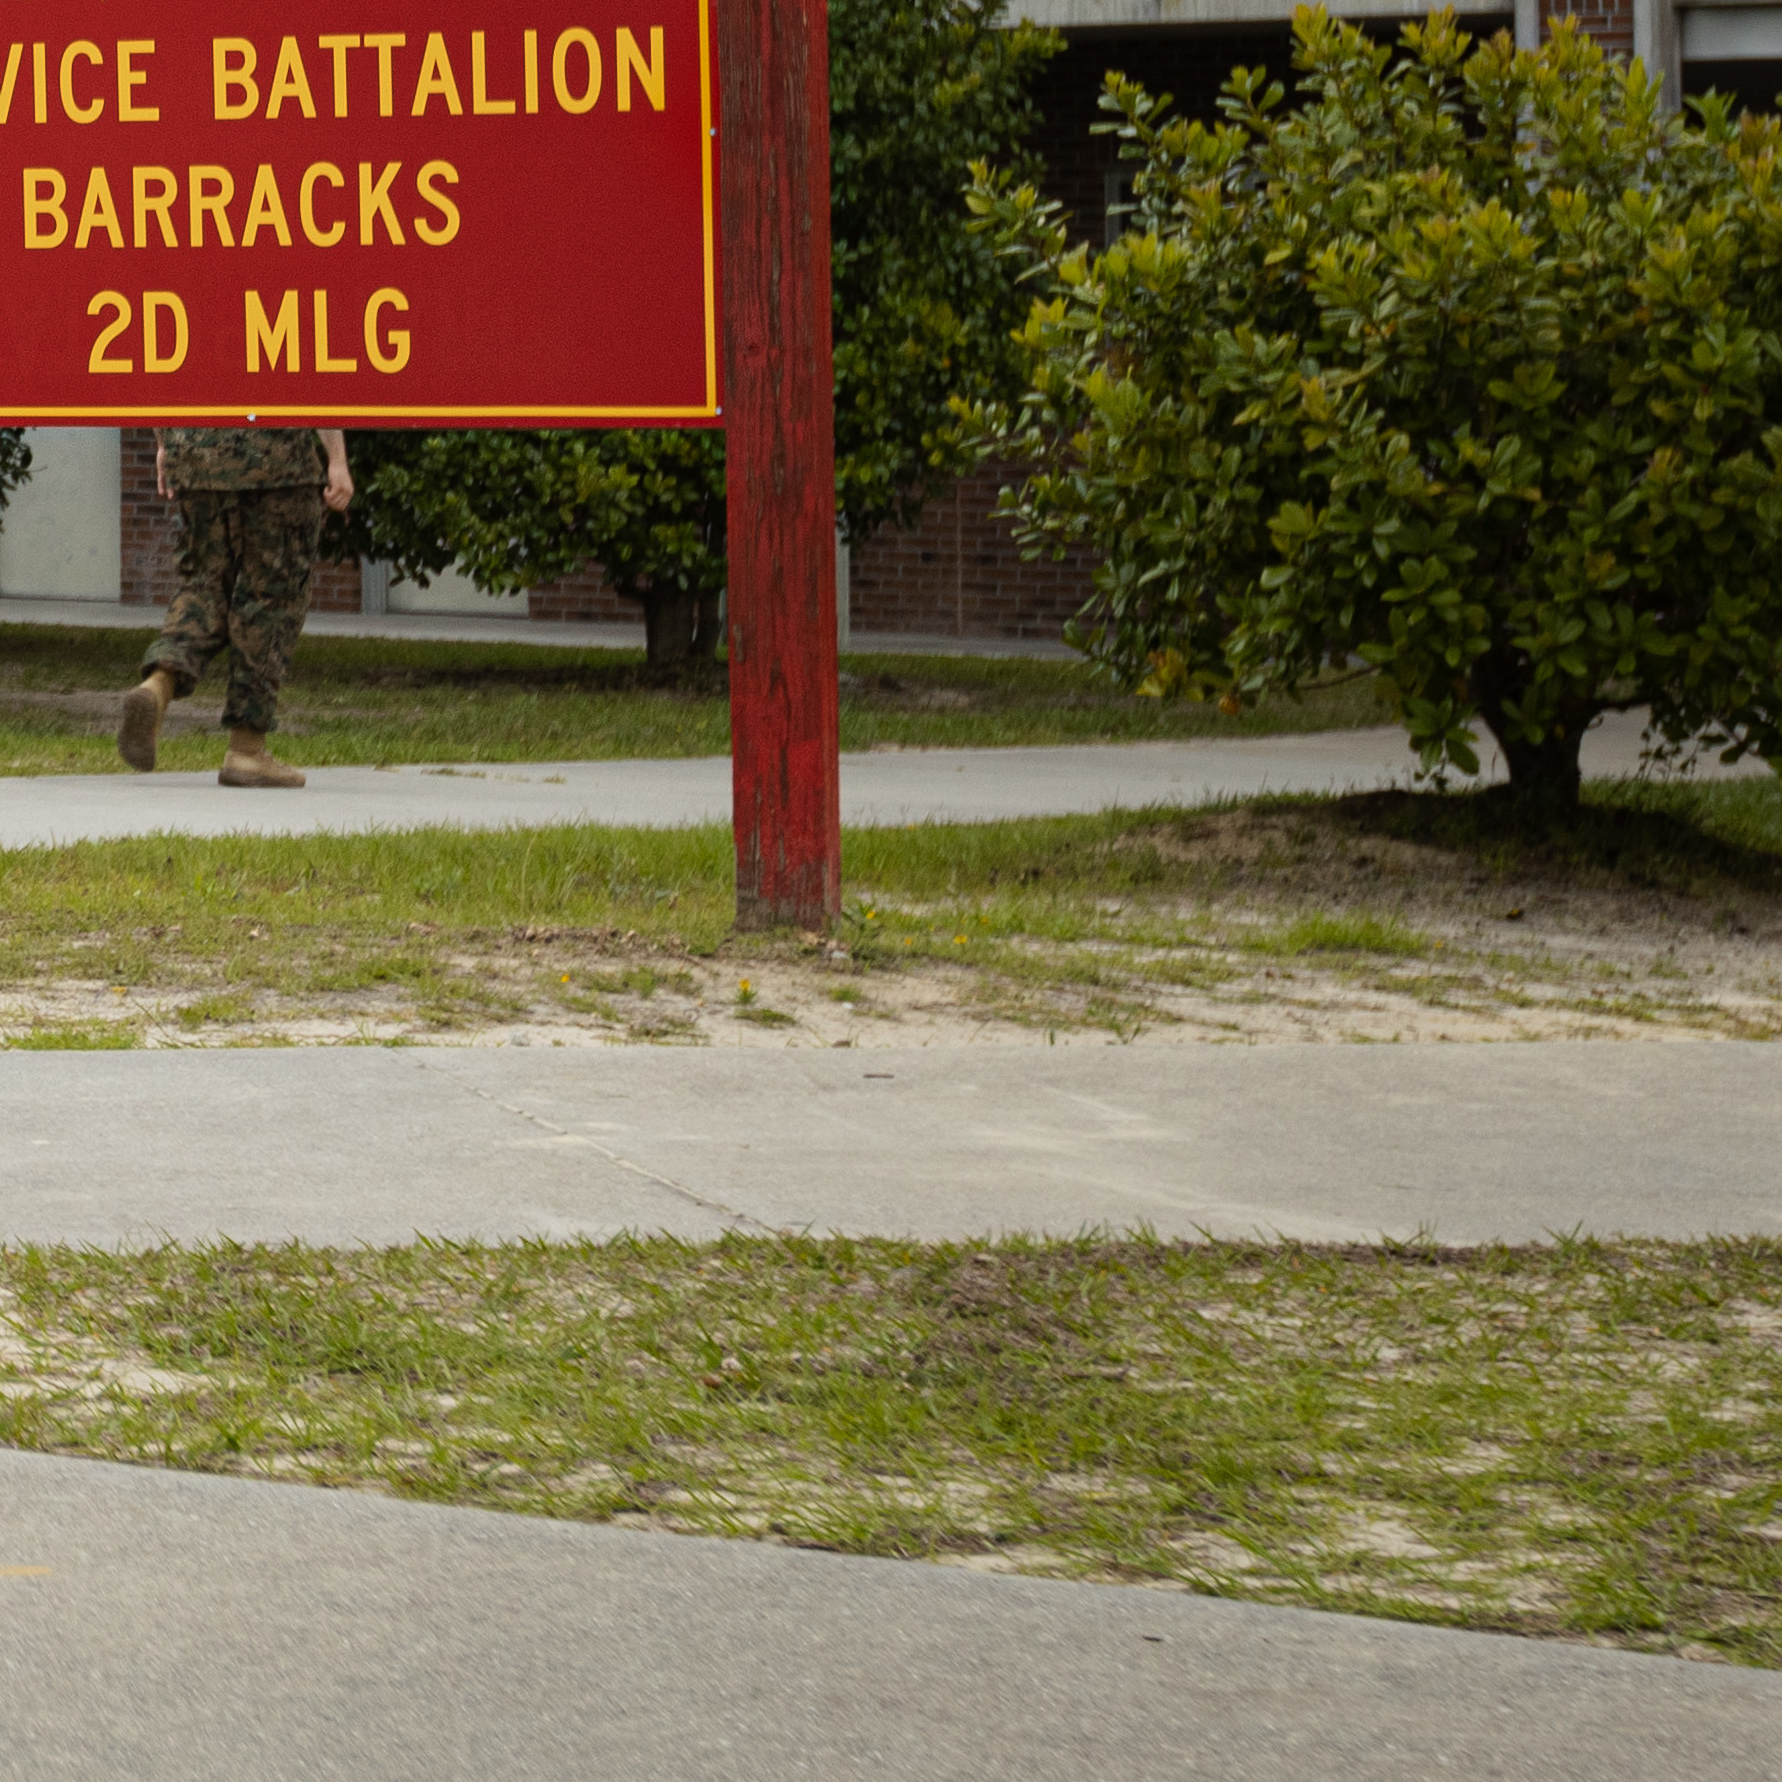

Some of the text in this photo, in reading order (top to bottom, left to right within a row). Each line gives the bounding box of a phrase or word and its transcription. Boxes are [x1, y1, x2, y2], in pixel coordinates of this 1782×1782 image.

[211, 25, 666, 121] BATTALION
[21, 159, 461, 250] BARRACKS
[86, 286, 412, 375] 2D MLG
